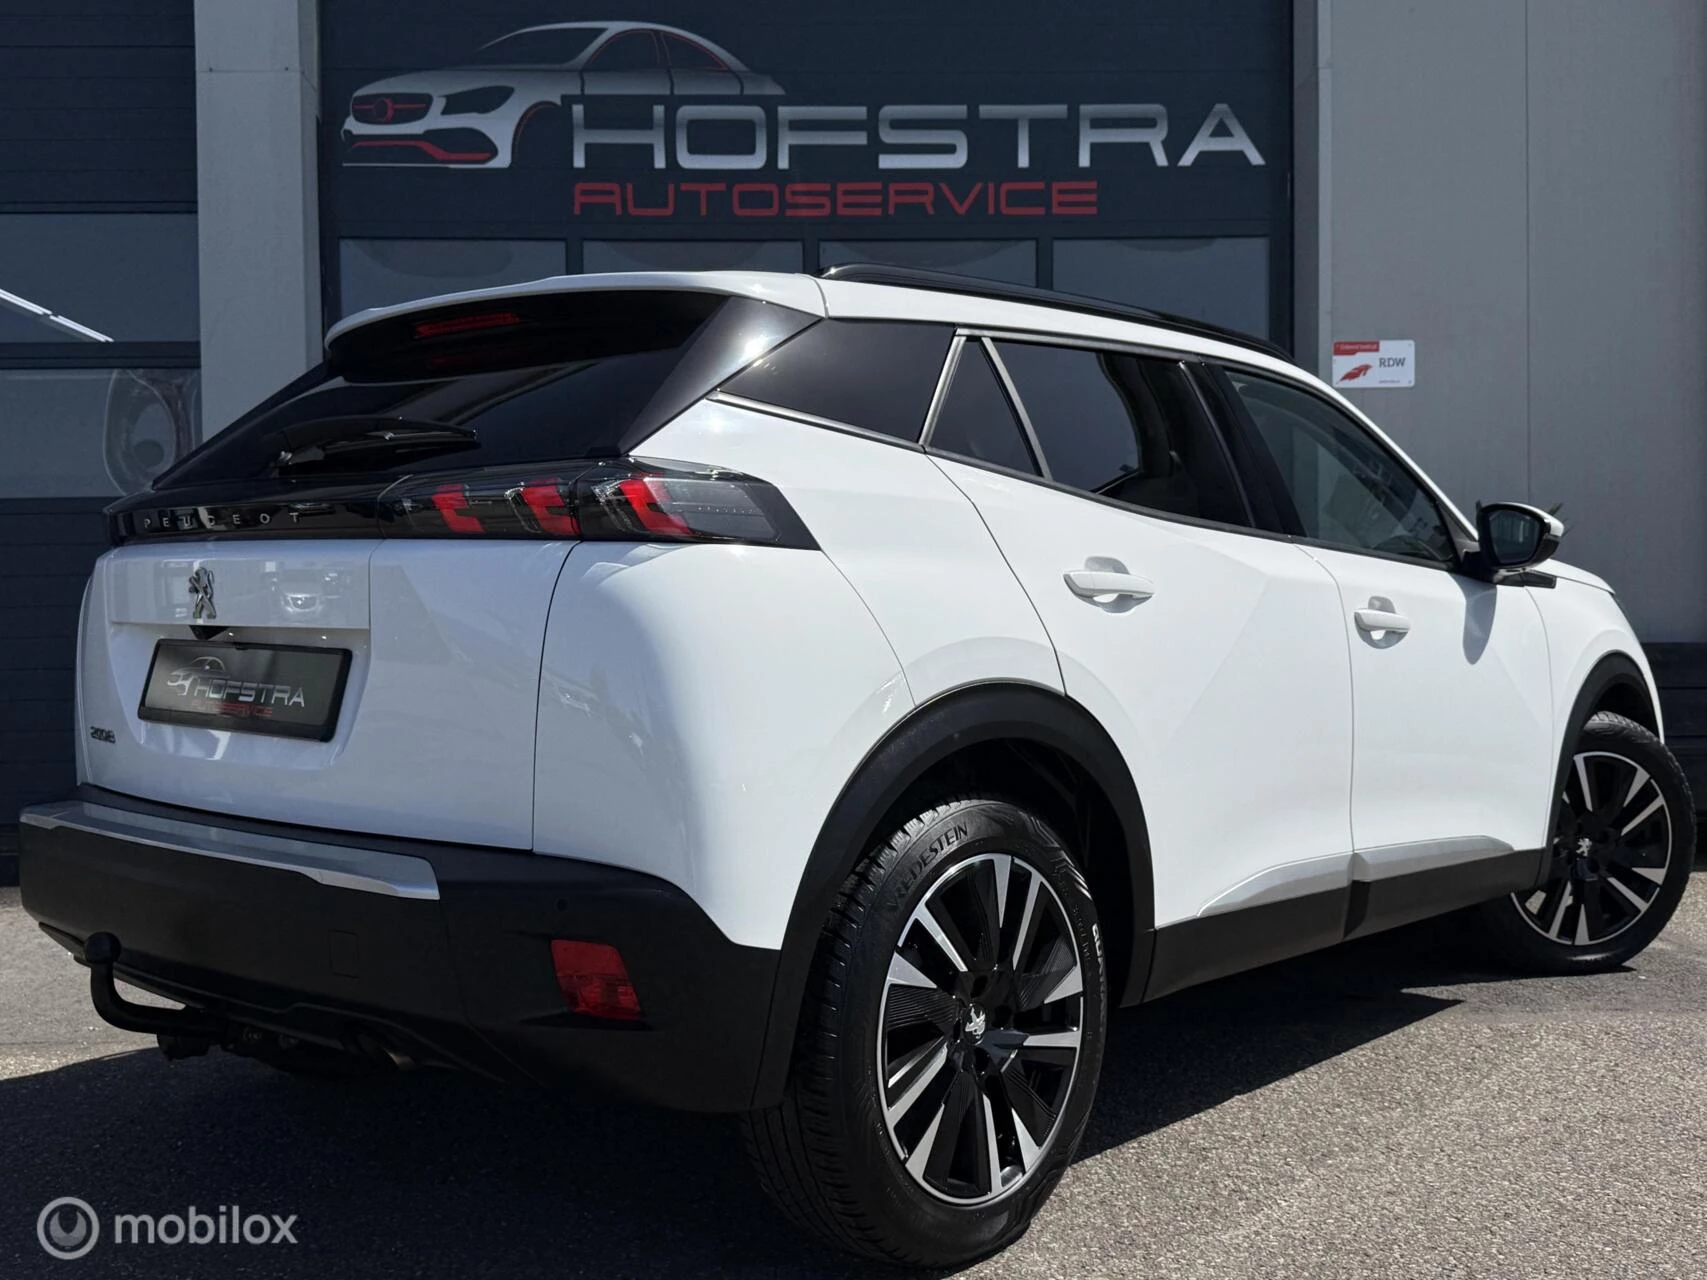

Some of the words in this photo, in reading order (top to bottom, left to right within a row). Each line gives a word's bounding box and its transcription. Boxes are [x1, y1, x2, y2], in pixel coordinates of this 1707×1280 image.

[573, 103, 1265, 170] HOFSTRA
[573, 182, 1098, 217] AUTOSERVICE
[1379, 357, 1406, 368] RDW
[144, 511, 299, 529] PEUGEOT
[193, 679, 305, 708] HOFSTRA
